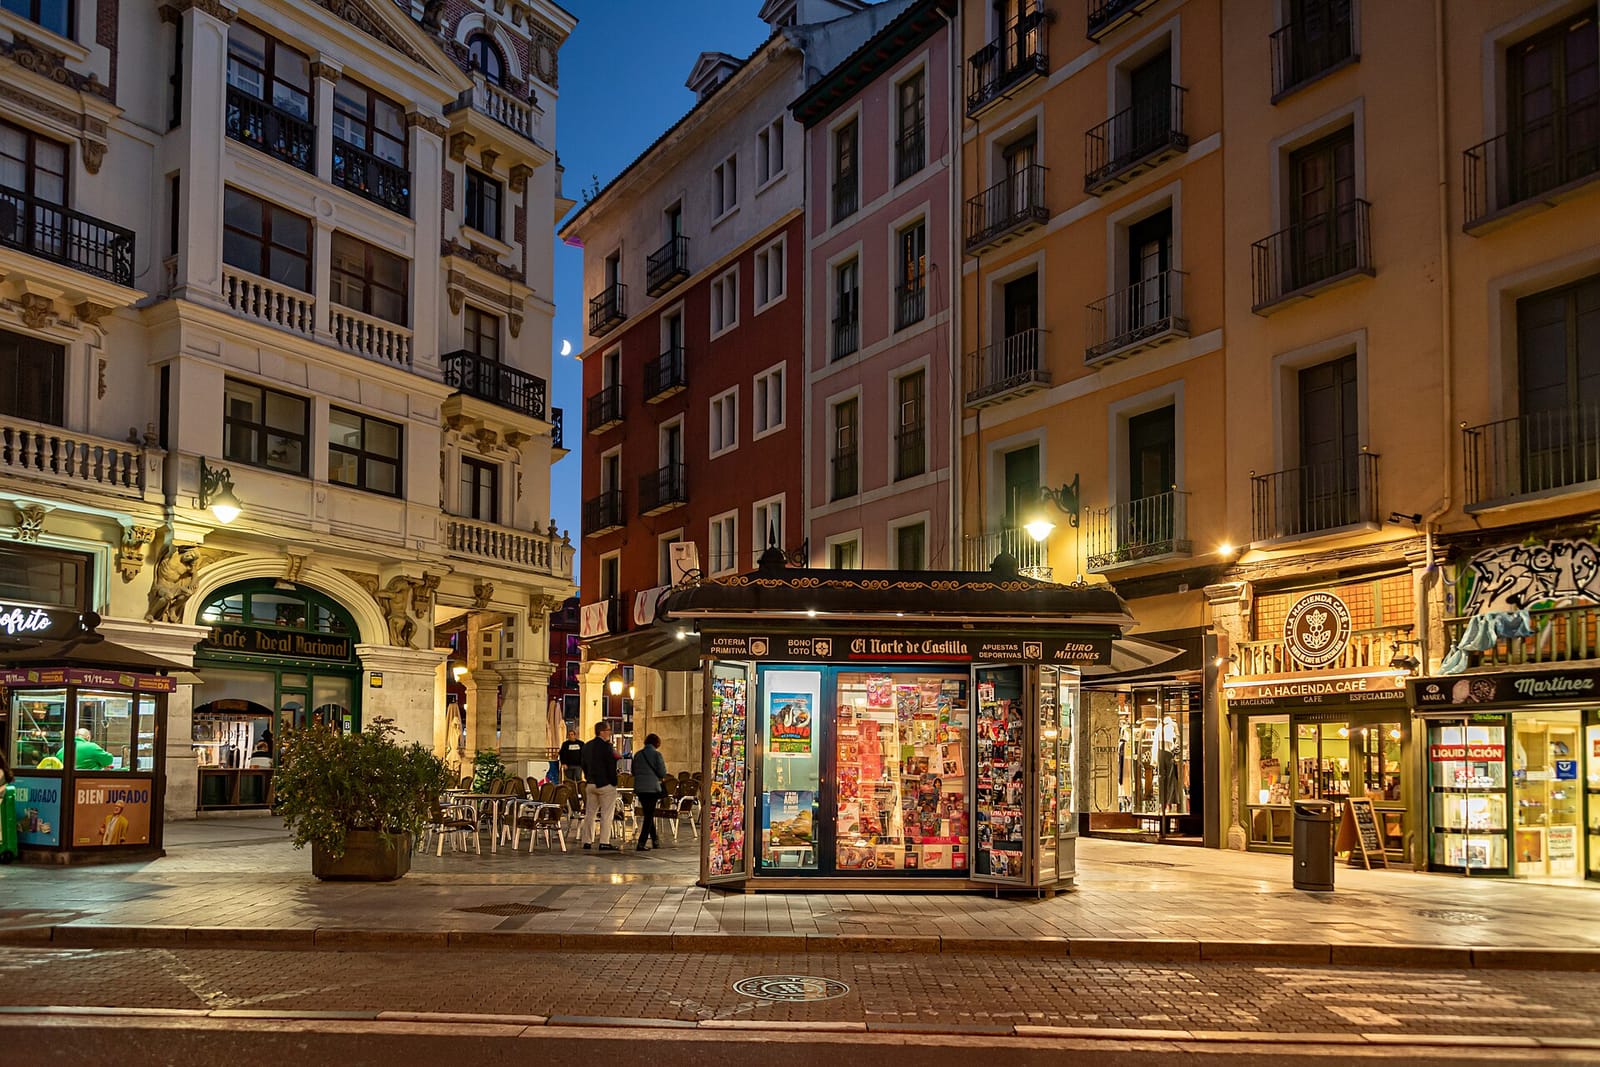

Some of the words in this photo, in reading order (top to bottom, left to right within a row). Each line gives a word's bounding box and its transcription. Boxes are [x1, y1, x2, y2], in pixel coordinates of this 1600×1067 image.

[0, 606, 52, 635] ofrito
[788, 639, 811, 647] BONO
[850, 639, 866, 654] El
[869, 639, 903, 654] Norte
[906, 640, 919, 654] de
[921, 639, 968, 655] Castilla
[1065, 642, 1093, 652] EURO
[711, 647, 747, 655] PRIMITIVA
[1054, 651, 1100, 660] MILLONES
[1258, 687, 1272, 698] LA
[1274, 681, 1333, 696] HACIENDA
[1335, 678, 1367, 691] CAFÉ
[1350, 691, 1404, 701] ESPECIALIDAD
[1432, 746, 1503, 758] LIQUIDACIÓN
[29, 788, 57, 804] JUGADO
[77, 789, 104, 805] BIEN
[105, 789, 149, 804] JUGADO
